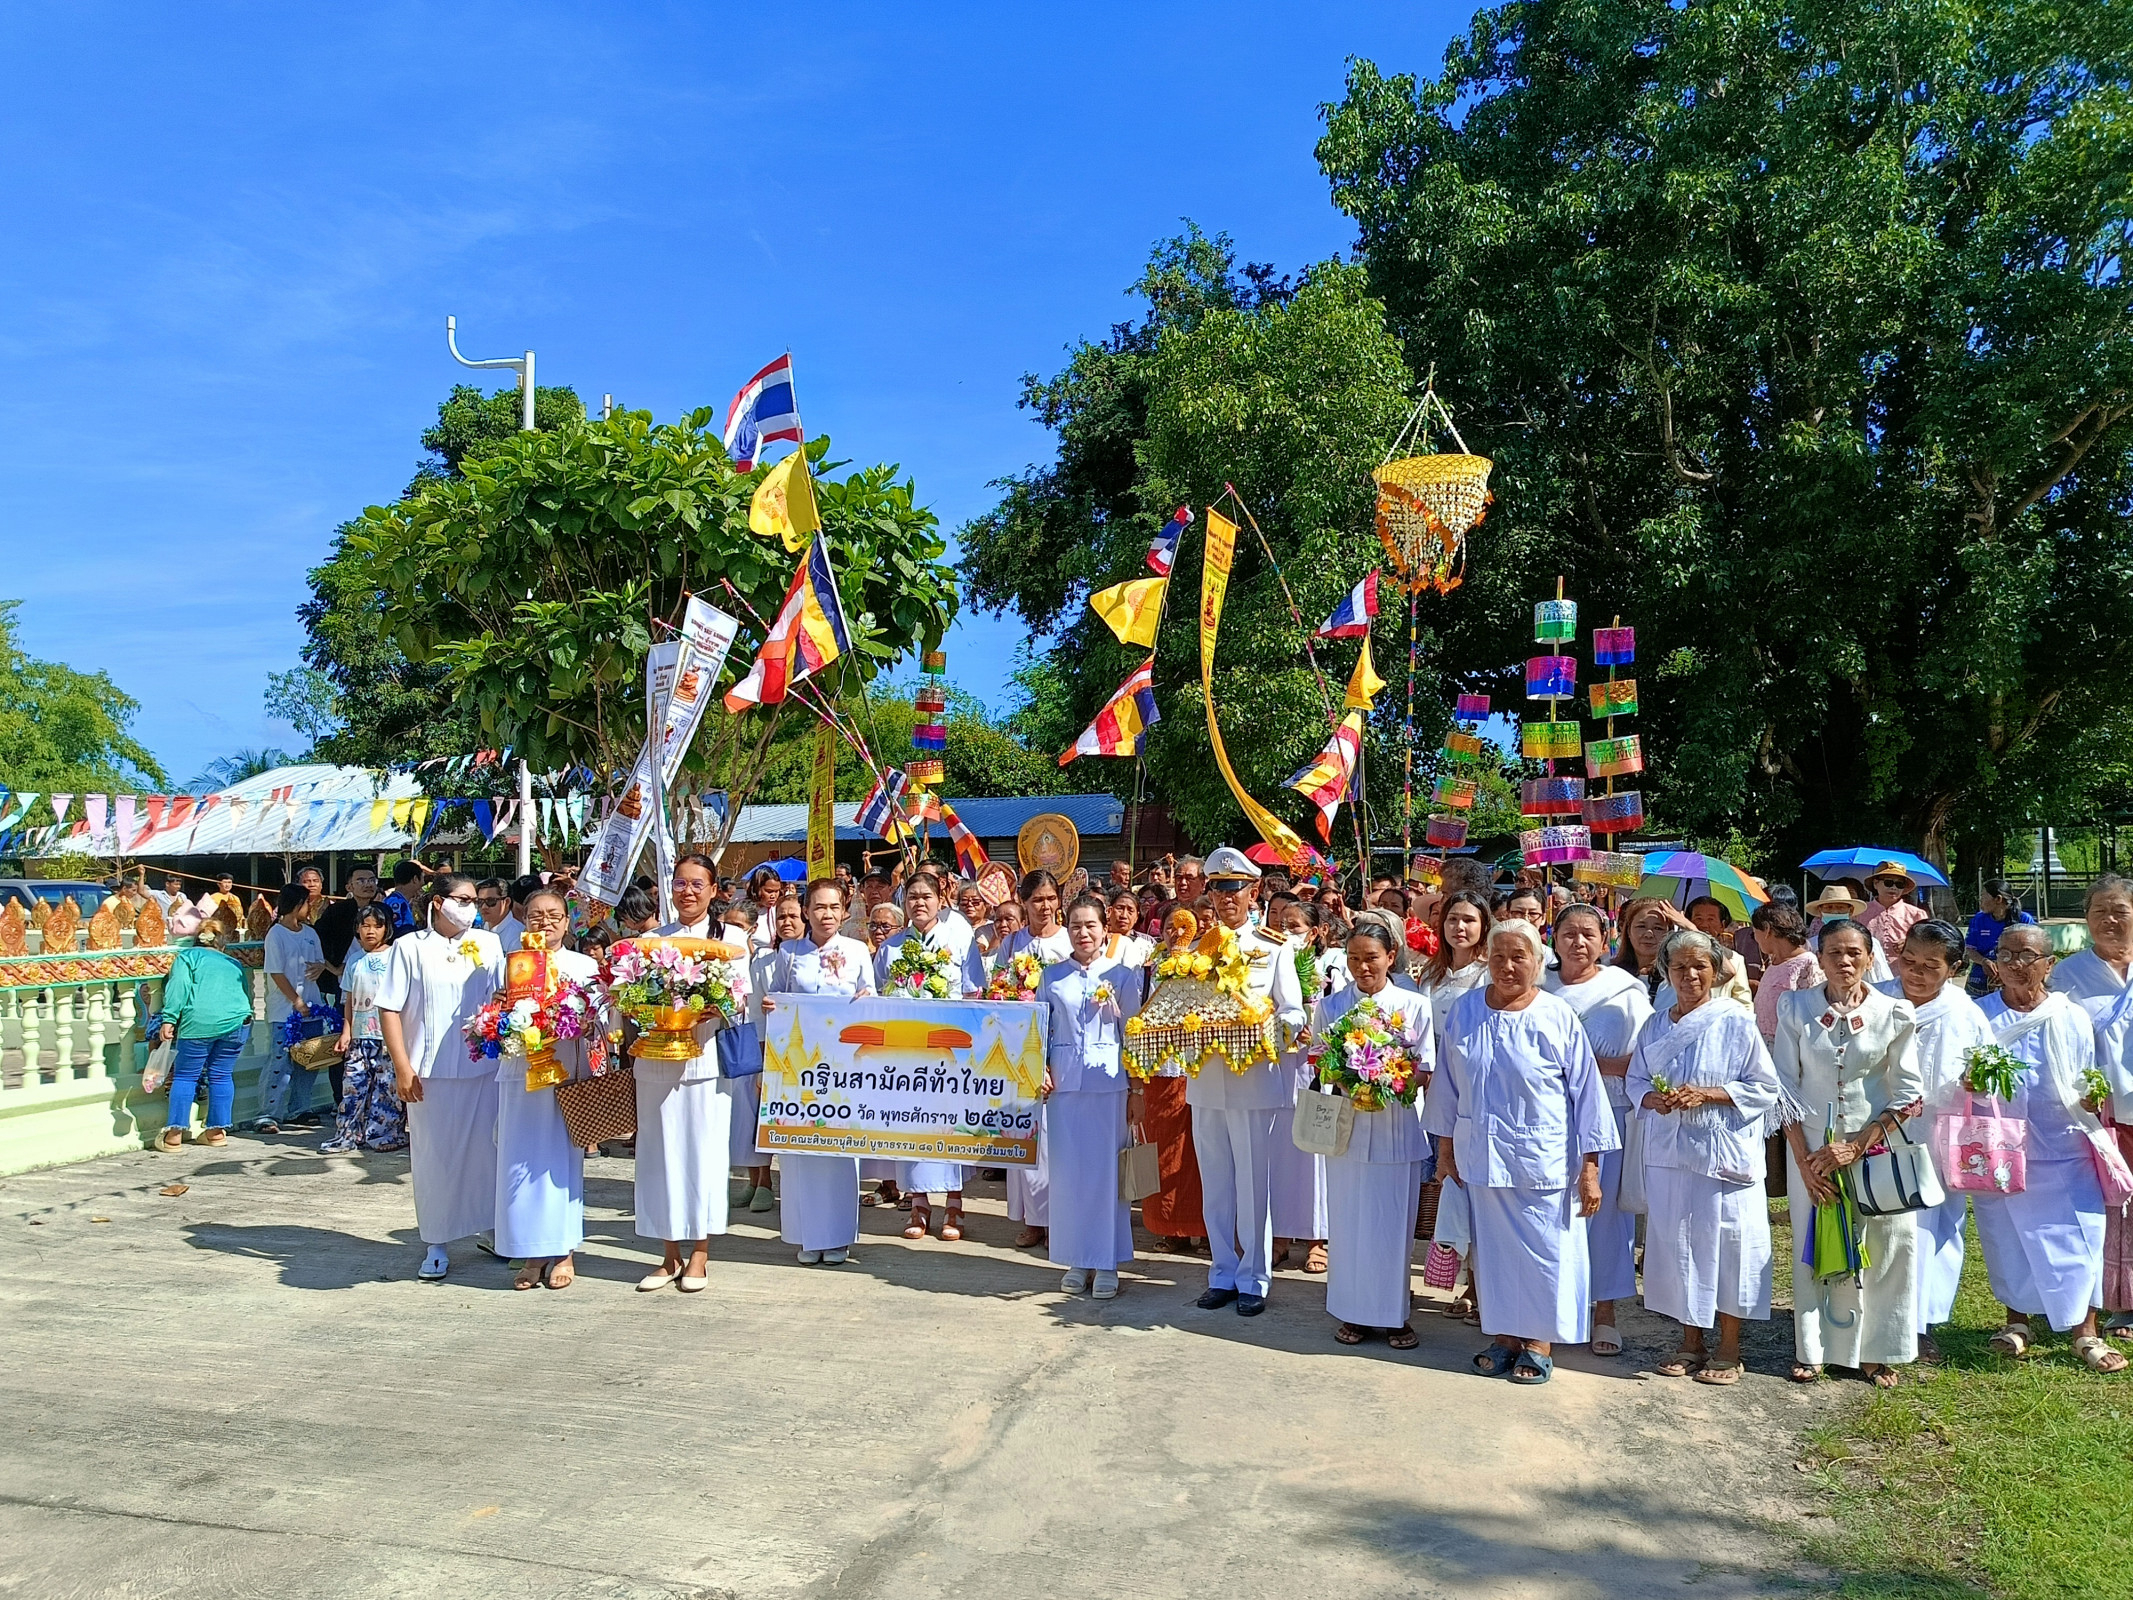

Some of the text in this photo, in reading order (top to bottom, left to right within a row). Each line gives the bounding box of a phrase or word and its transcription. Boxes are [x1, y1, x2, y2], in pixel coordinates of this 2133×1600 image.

[800, 1061, 1005, 1096] กฐินสามัคคีทั่วไทย
[769, 1101, 1033, 1130] ๓๐,๐๐๐ วัด พุทธศักราช ๒๕๖๘
[769, 1131, 1027, 1158] โดย คณะศิษยานุศิษย์ บูชาธรรม ๘๑ ปี หลวงพ่อธัมมชโย
